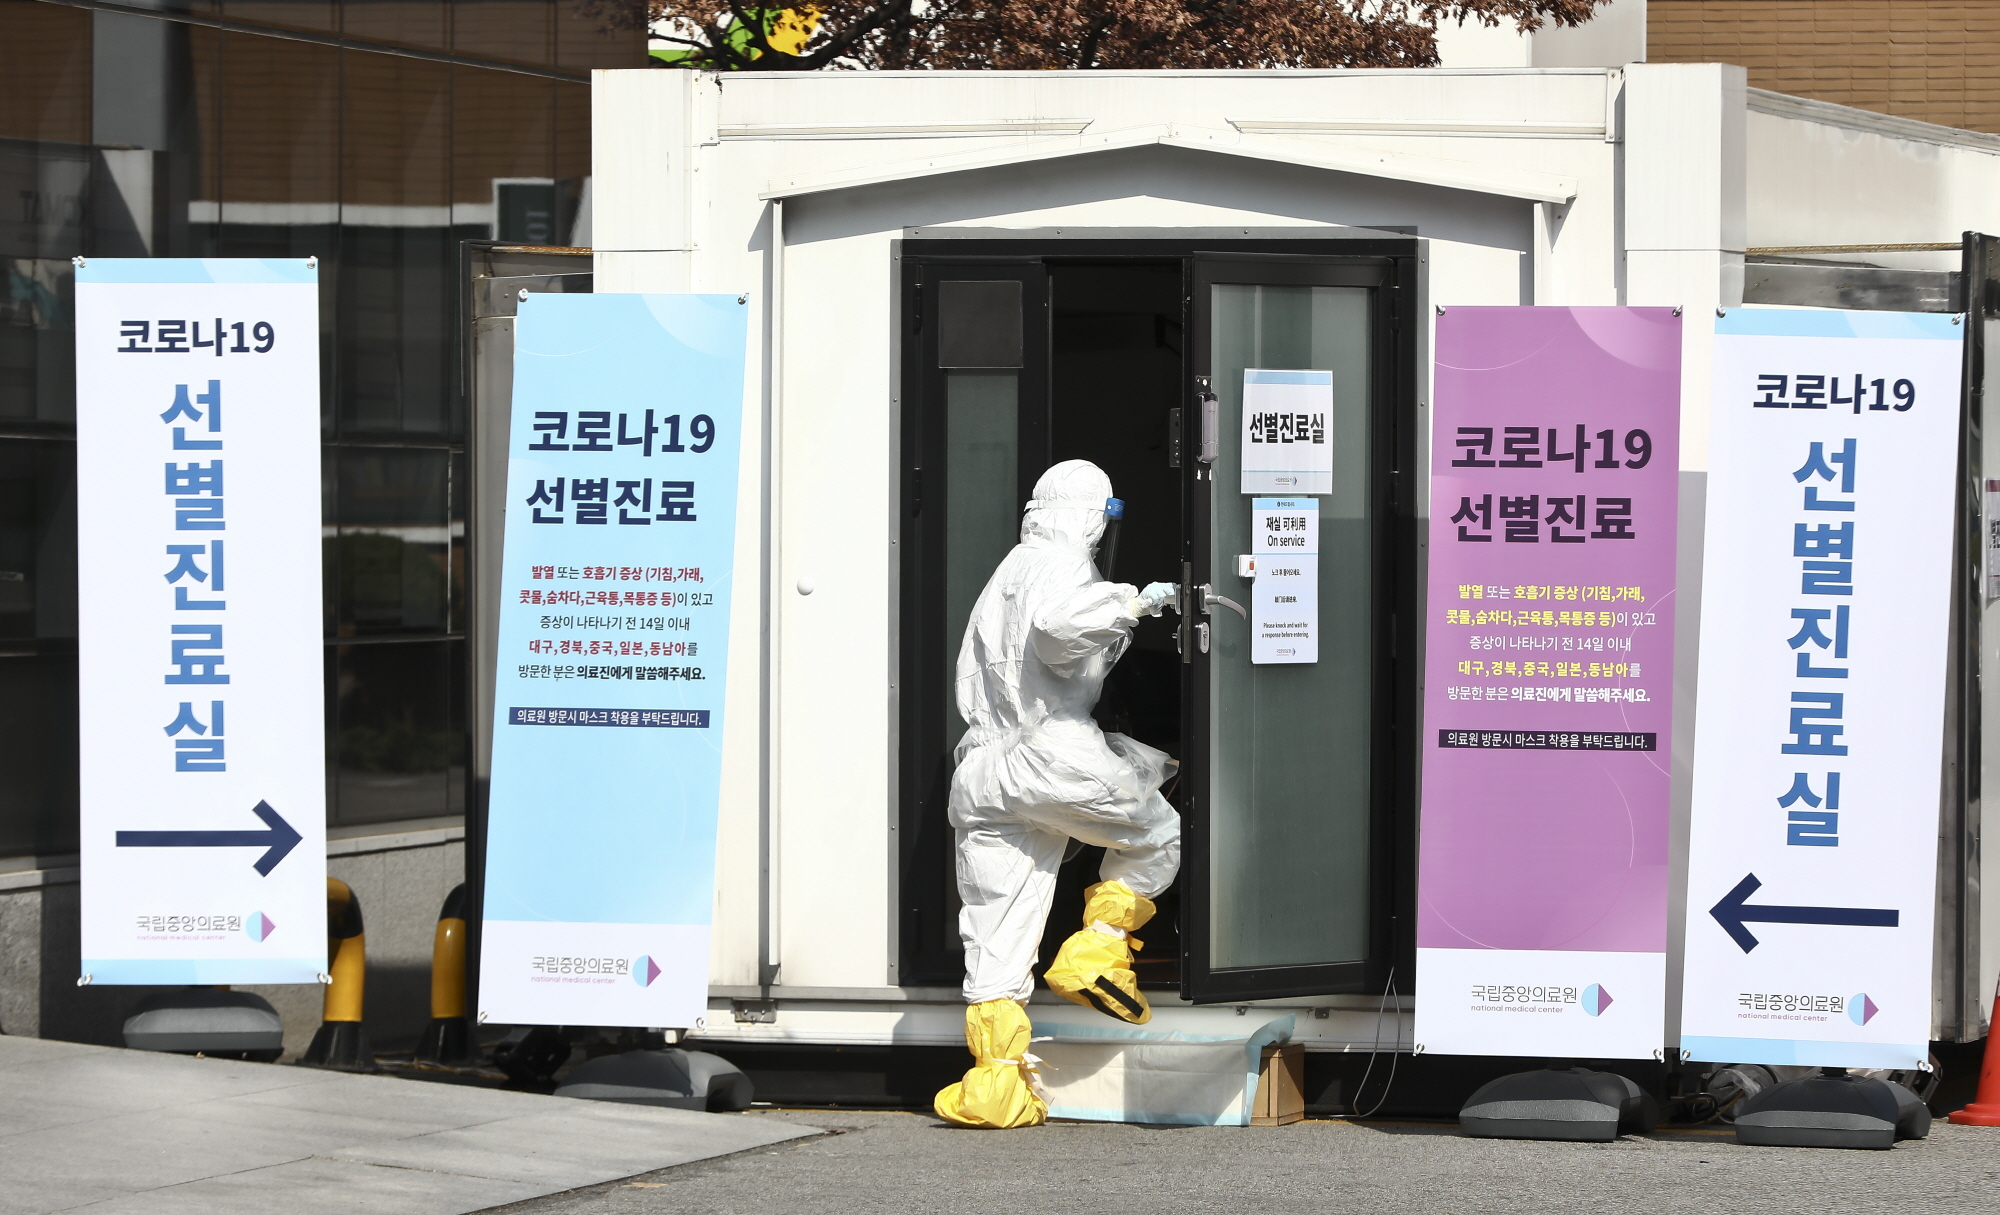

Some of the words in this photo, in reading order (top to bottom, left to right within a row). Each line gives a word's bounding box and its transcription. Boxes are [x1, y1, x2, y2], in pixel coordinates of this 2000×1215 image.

[117, 318, 275, 356] 코로나19
[1752, 373, 1916, 414] 코로나19
[528, 408, 716, 457] 코로나19
[1249, 412, 1325, 444] 선별진료실
[1451, 424, 1653, 474] 코로나19
[526, 476, 697, 526] 선별진료
[1266, 516, 1280, 532] 재실
[1282, 516, 1306, 531] 可利用
[1450, 494, 1636, 544] 선별진료
[1268, 534, 1278, 546] On
[1280, 534, 1305, 546] service
[159, 379, 231, 772] 선별진료실
[531, 565, 555, 580] 발열
[557, 566, 580, 580] 또는
[582, 566, 616, 581] 호흡기
[619, 566, 642, 581] 증상
[645, 566, 704, 583] (기침,가래,
[660, 592, 688, 608] 등)이
[691, 592, 714, 607] 있고
[1458, 584, 1484, 600] 발열
[1486, 585, 1511, 600] 또는
[1514, 585, 1551, 600] 호흡기
[1554, 586, 1578, 600] 증상
[1581, 586, 1646, 603] (기침,가래,
[540, 615, 574, 630] 증상이
[576, 616, 622, 630] 나타나기
[625, 616, 636, 630] 전
[640, 617, 664, 631] 14일
[667, 617, 690, 631] 이내
[1598, 611, 1628, 628] 등)이
[1632, 612, 1656, 627] 있고
[1469, 635, 1506, 650] 증상이
[1509, 636, 1558, 650] 나타나기
[1561, 636, 1574, 650] 전
[1576, 636, 1604, 652] 14일
[1606, 637, 1632, 652] 이내
[1776, 438, 1858, 848] 선별진료실
[518, 665, 552, 679] 방문한
[553, 666, 575, 680] 분은
[576, 666, 632, 680] 의료진에게
[635, 666, 706, 682] 말씀해주세요.
[1447, 686, 1483, 700] 방문한
[1485, 686, 1508, 700] 분은
[1510, 686, 1571, 702] 의료진에게
[1574, 688, 1651, 704] 말씀해주세요.
[517, 710, 546, 724] 의료원
[548, 710, 577, 724] 방문시
[579, 710, 608, 724] 마스크
[610, 711, 640, 725] 착용을
[641, 711, 702, 726] 부탁드립니다.
[1447, 732, 1478, 746] 의료원
[1481, 733, 1512, 747] 방문시
[1515, 733, 1546, 747] 마스크
[1548, 734, 1580, 748] 착용을
[1582, 734, 1648, 748] 부탁드립니다.
[136, 915, 241, 932] 국립중앙의료원
[532, 956, 628, 975] 국립중앙의료원
[1471, 984, 1577, 1004] 국립중앙의료원
[1738, 993, 1844, 1013] 국립중앙의료원
